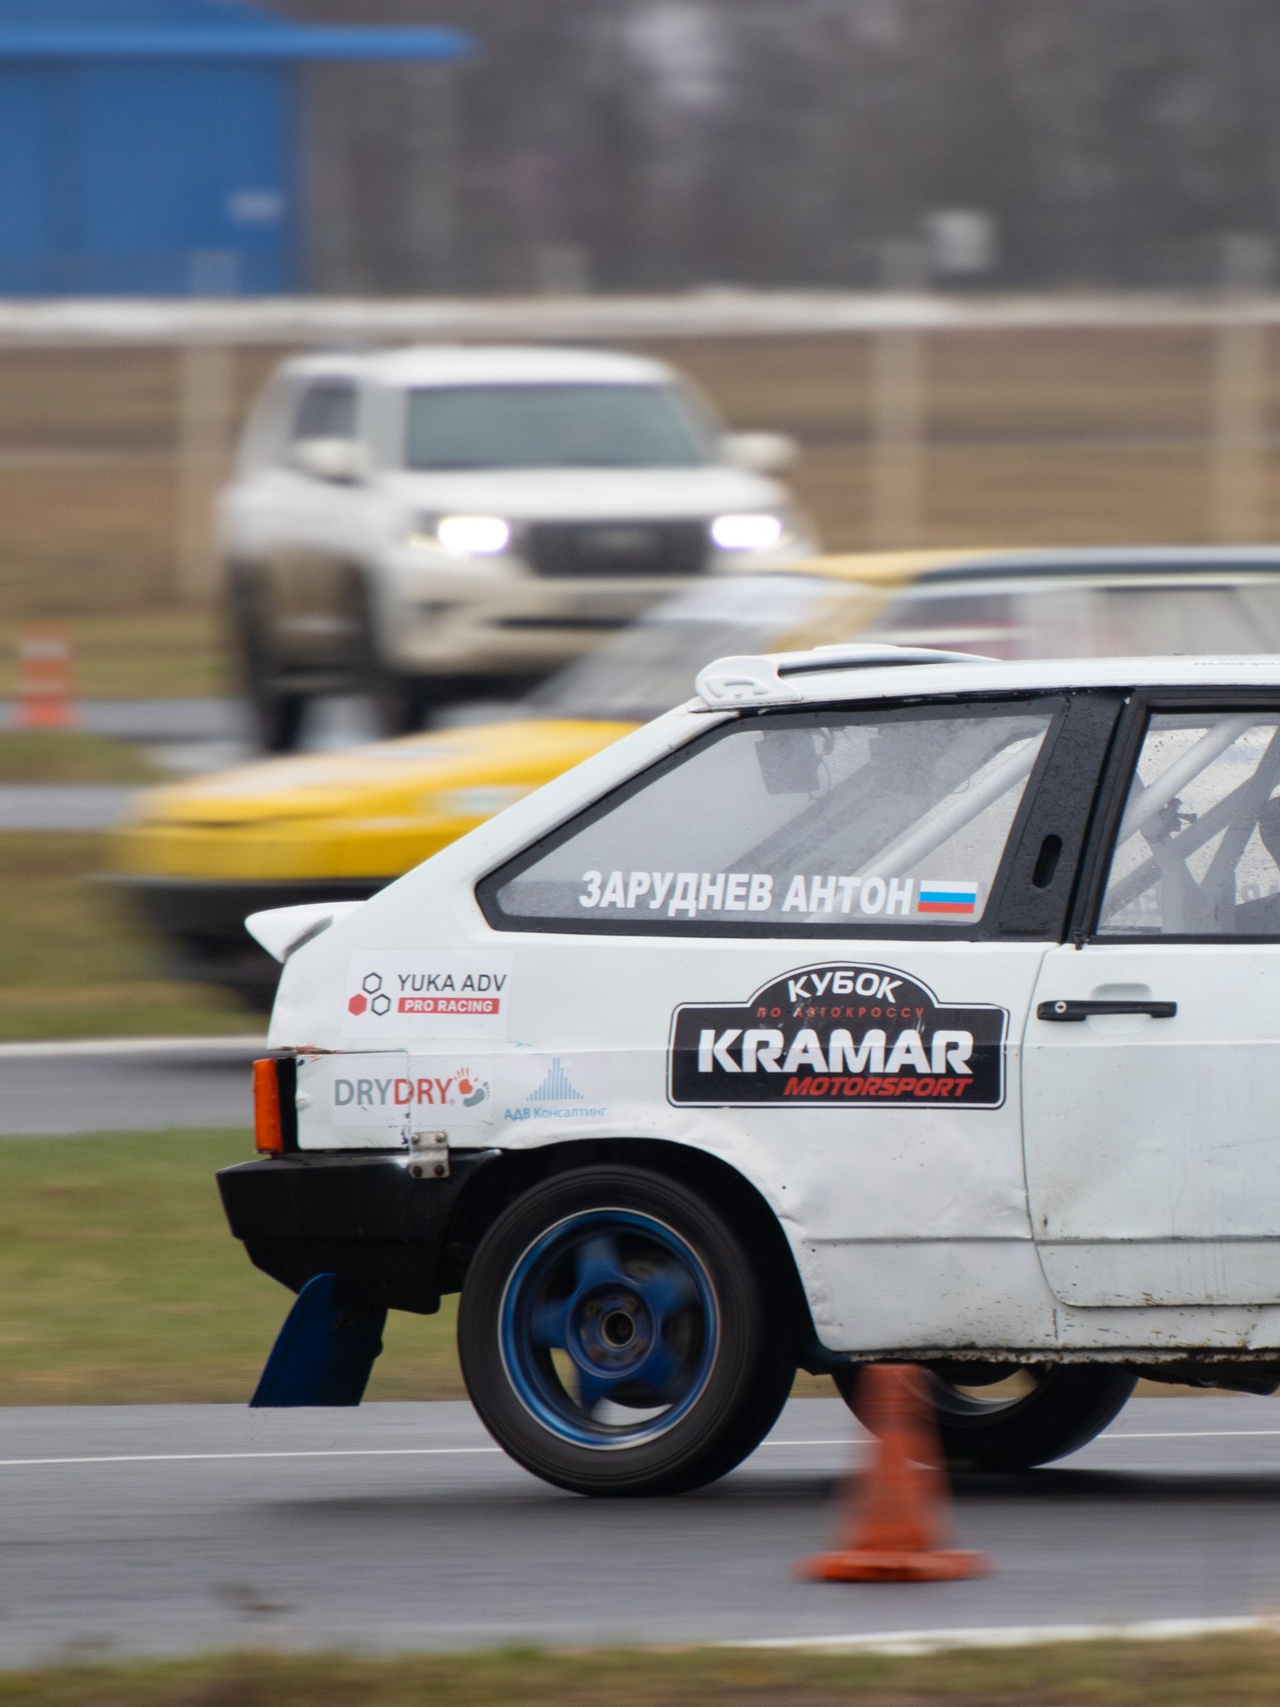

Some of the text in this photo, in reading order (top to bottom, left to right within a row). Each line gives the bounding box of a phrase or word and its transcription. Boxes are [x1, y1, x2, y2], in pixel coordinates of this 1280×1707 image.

[578, 870, 915, 917] ЗАРУДНЕВ АНТОН
[397, 973, 508, 992] YUKA ADV
[787, 970, 904, 1004] КУБОК
[404, 1000, 494, 1014] PRO RACING
[756, 1006, 783, 1018] ПО
[697, 1028, 975, 1075] KRAMAR
[334, 1078, 454, 1106] DRYDRY
[782, 1076, 974, 1097] MOTORSPORT
[504, 1107, 608, 1121] АДВ Консалтинг
